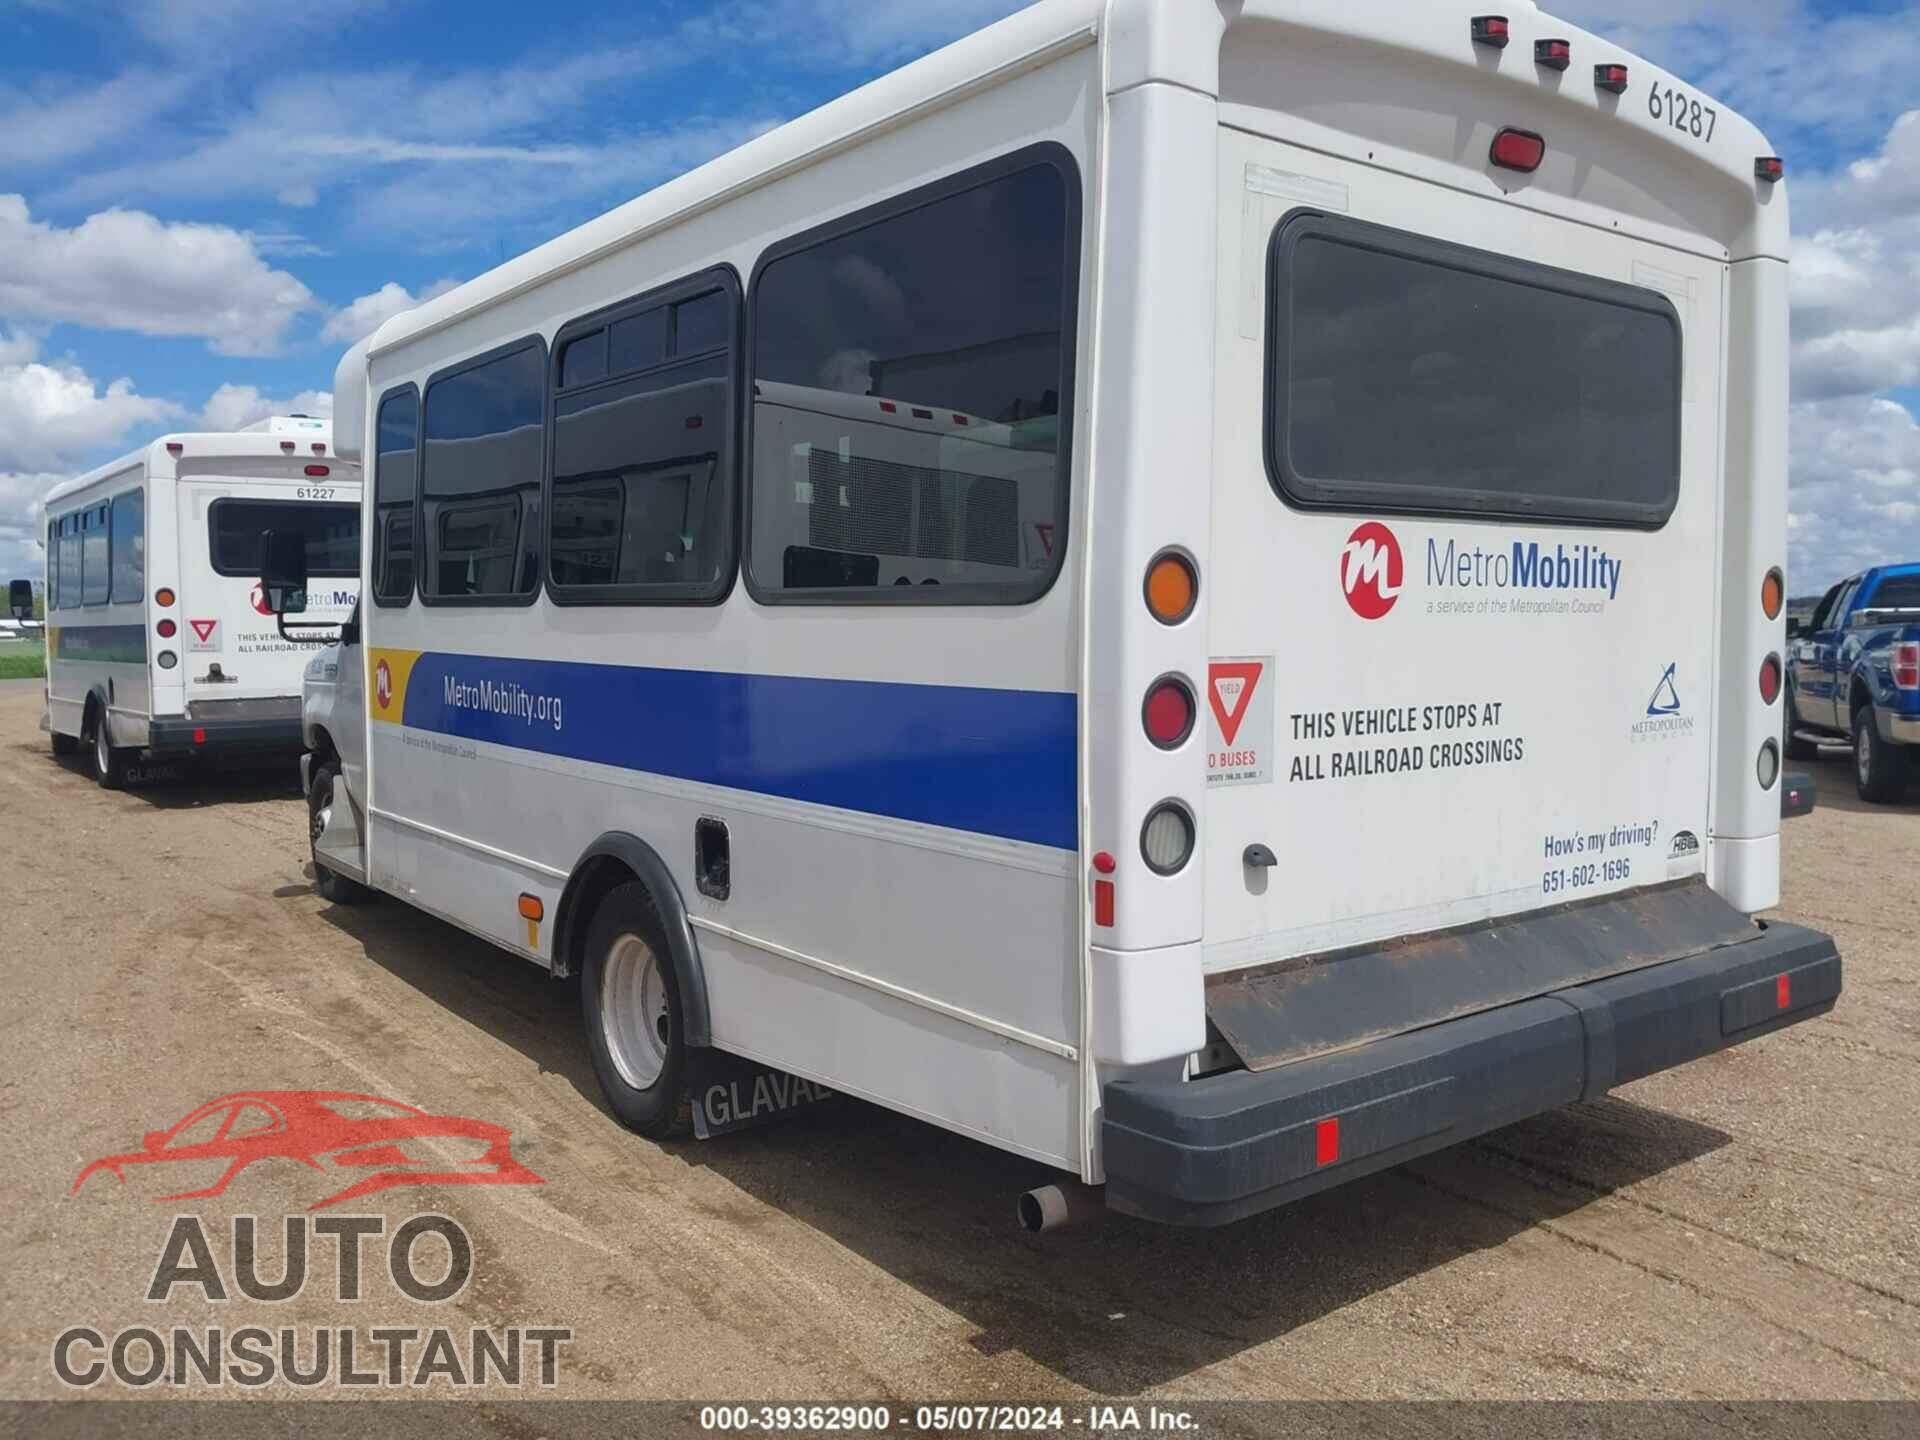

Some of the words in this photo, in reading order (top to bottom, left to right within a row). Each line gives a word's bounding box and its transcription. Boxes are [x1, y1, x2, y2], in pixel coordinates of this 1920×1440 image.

[1648, 81, 1717, 143] 61287
[297, 488, 336, 499] 61227
[1427, 538, 1622, 600] MetroMobility
[1437, 600, 1474, 614] service
[238, 633, 257, 641] THIS
[238, 644, 253, 653] ALL
[255, 643, 298, 653] RAILROAD
[443, 675, 562, 731] MetroMobility.org
[1291, 712, 1336, 740] THIS
[1342, 708, 1417, 736] VEHICLE
[1423, 704, 1477, 731] STOPS
[1482, 703, 1502, 726] AT
[1220, 751, 1256, 767] BUSES
[1290, 755, 1325, 782] ALL
[1331, 746, 1424, 778] RAILROAD
[1430, 737, 1524, 768] CROSSINGS
[1545, 831, 1584, 858] How's
[1587, 837, 1606, 855] my
[1609, 820, 1658, 850] driving?
[1543, 858, 1630, 893] 651-602-1696
